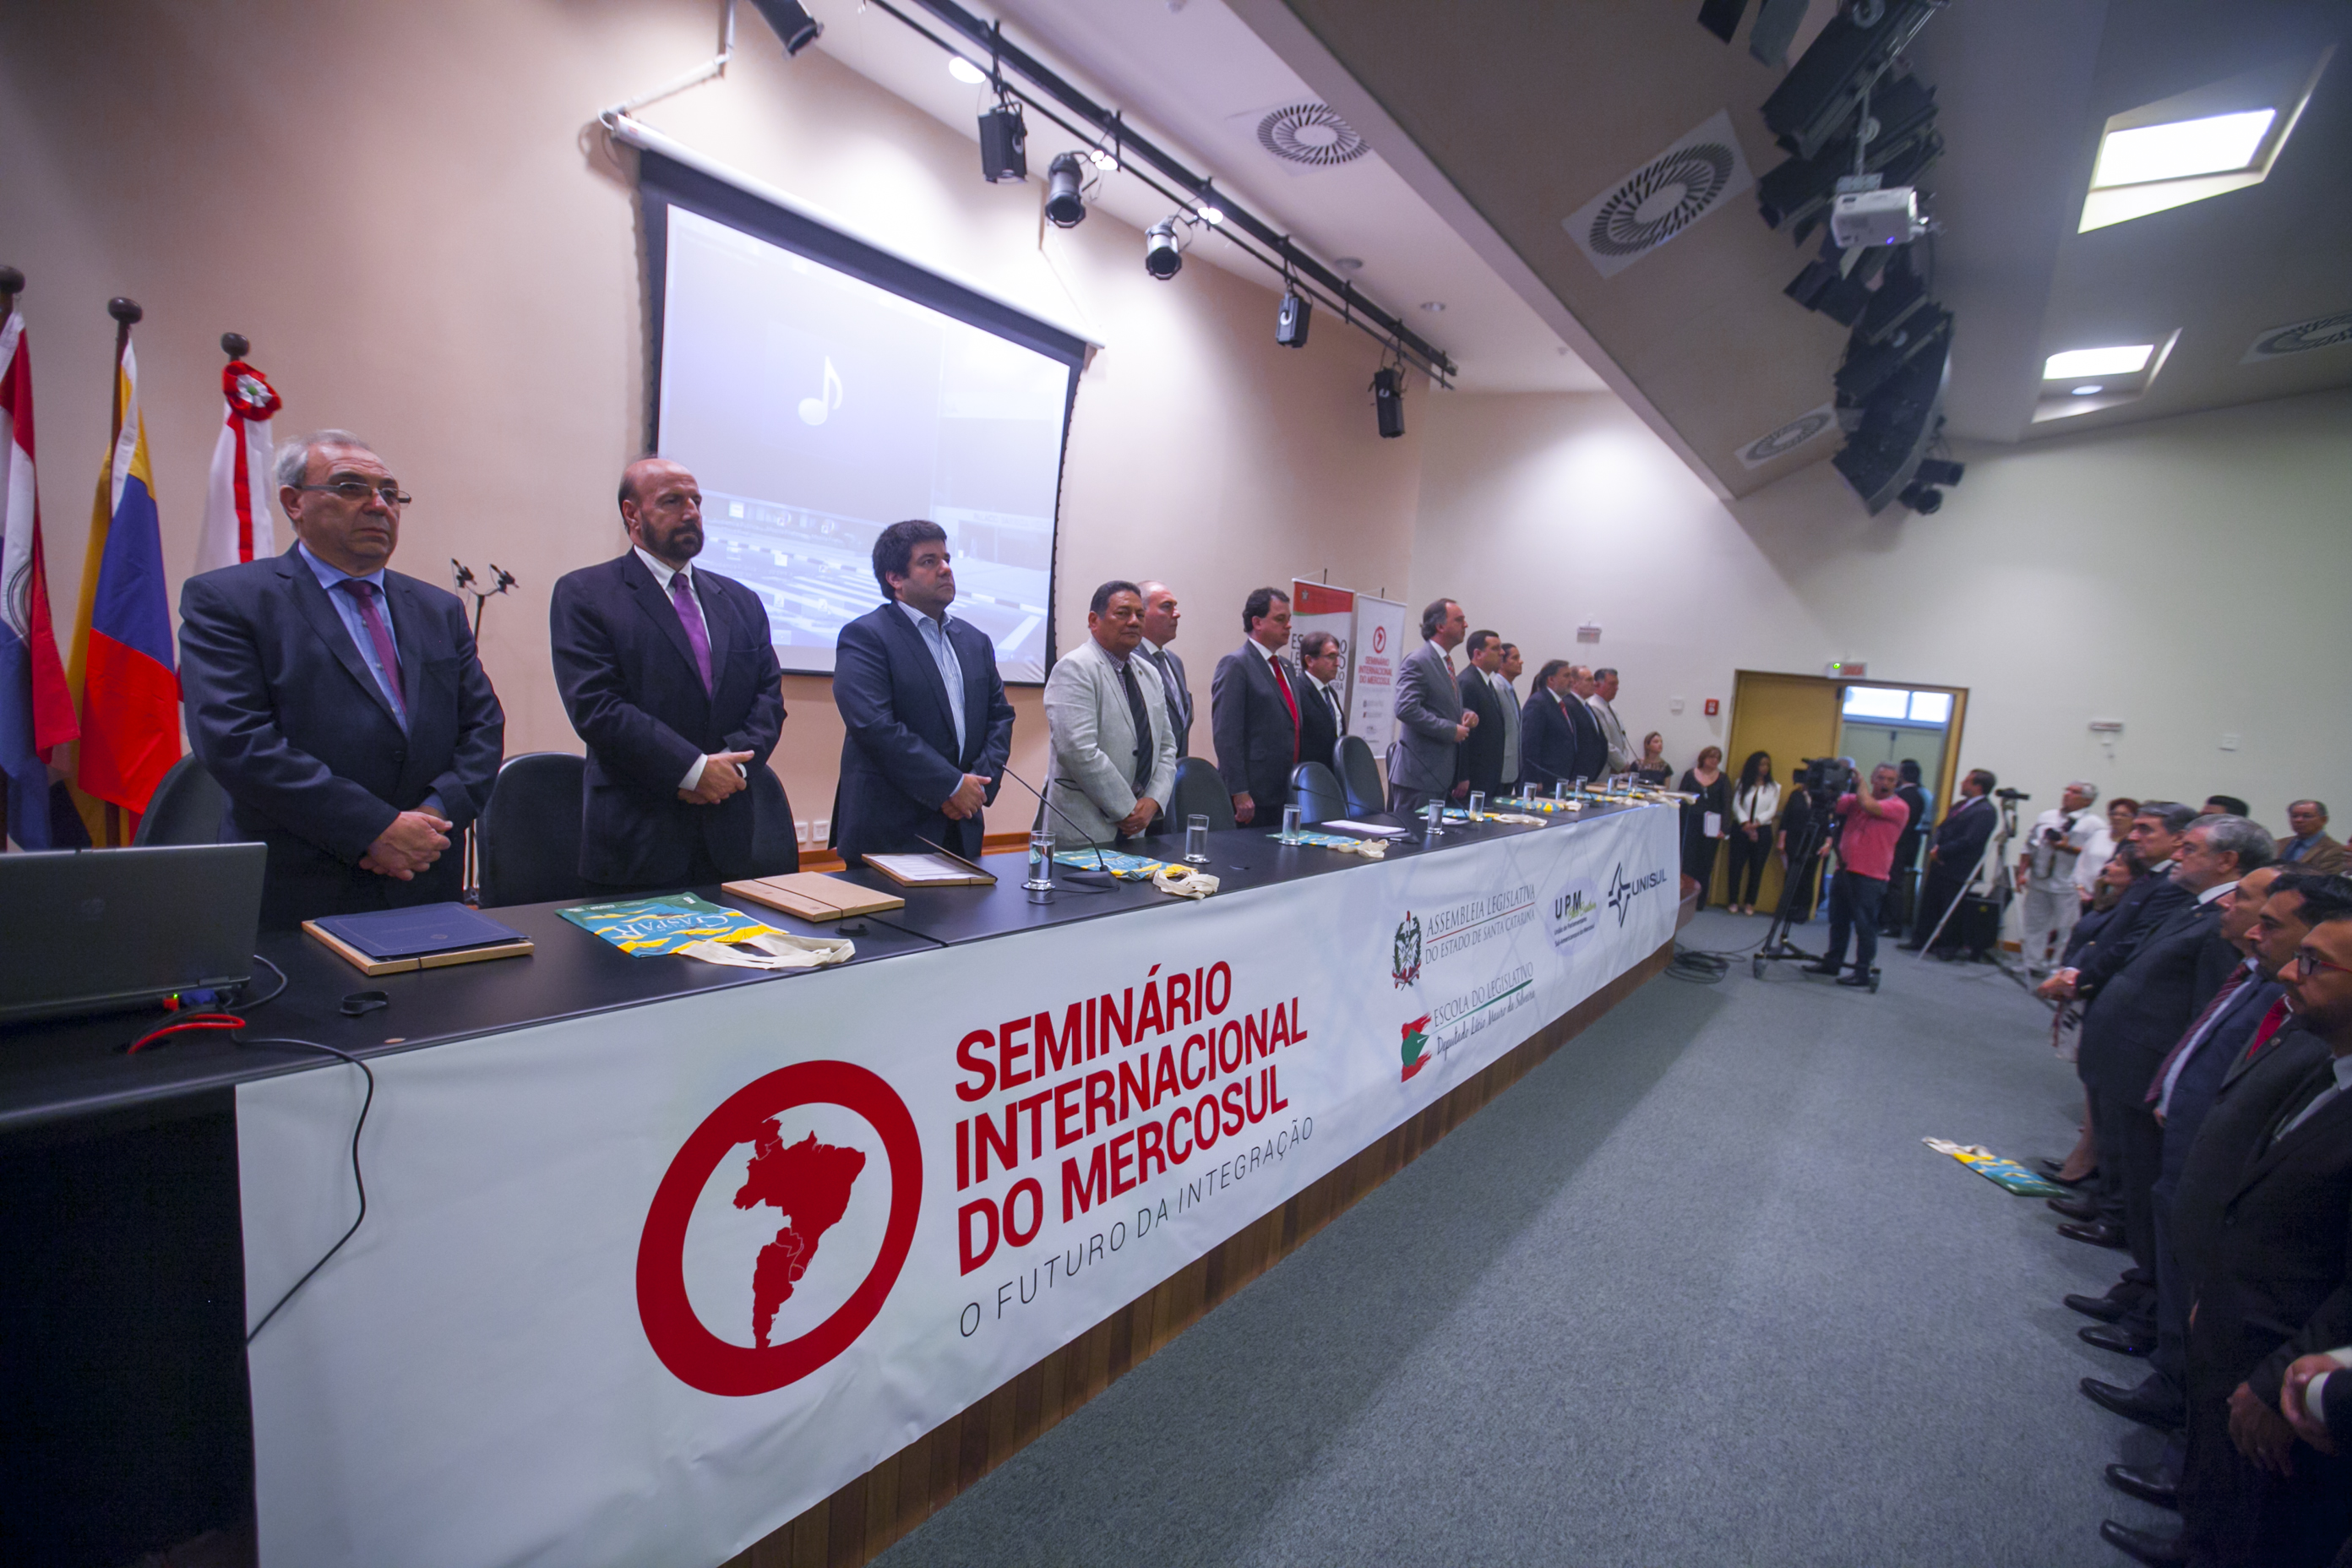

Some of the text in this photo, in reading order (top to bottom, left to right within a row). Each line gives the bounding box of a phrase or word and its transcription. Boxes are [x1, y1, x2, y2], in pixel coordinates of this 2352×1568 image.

[1358, 665, 1393, 676] INTERNACIONAL
[1358, 675, 1391, 685] DO MERCOSUL
[1555, 890, 1582, 920] UPM
[1631, 868, 1667, 896] UNISUL
[1425, 908, 1535, 964] DO ESTADO DE SANTA CATARINA
[1426, 884, 1535, 938] ASSEMBLEIA LEGISLATIVA
[1434, 961, 1534, 1027] ESCOLA DO LEGISLATIVO
[956, 961, 1231, 1102] SEMINÁRIO
[1437, 1021, 1469, 1062] Deputado
[956, 996, 1308, 1192] INTERNACIONAL
[958, 1064, 1288, 1277] DO MERCOSUL
[960, 1116, 1314, 1338] O FUTURO DA INTEGRAÇÃO
